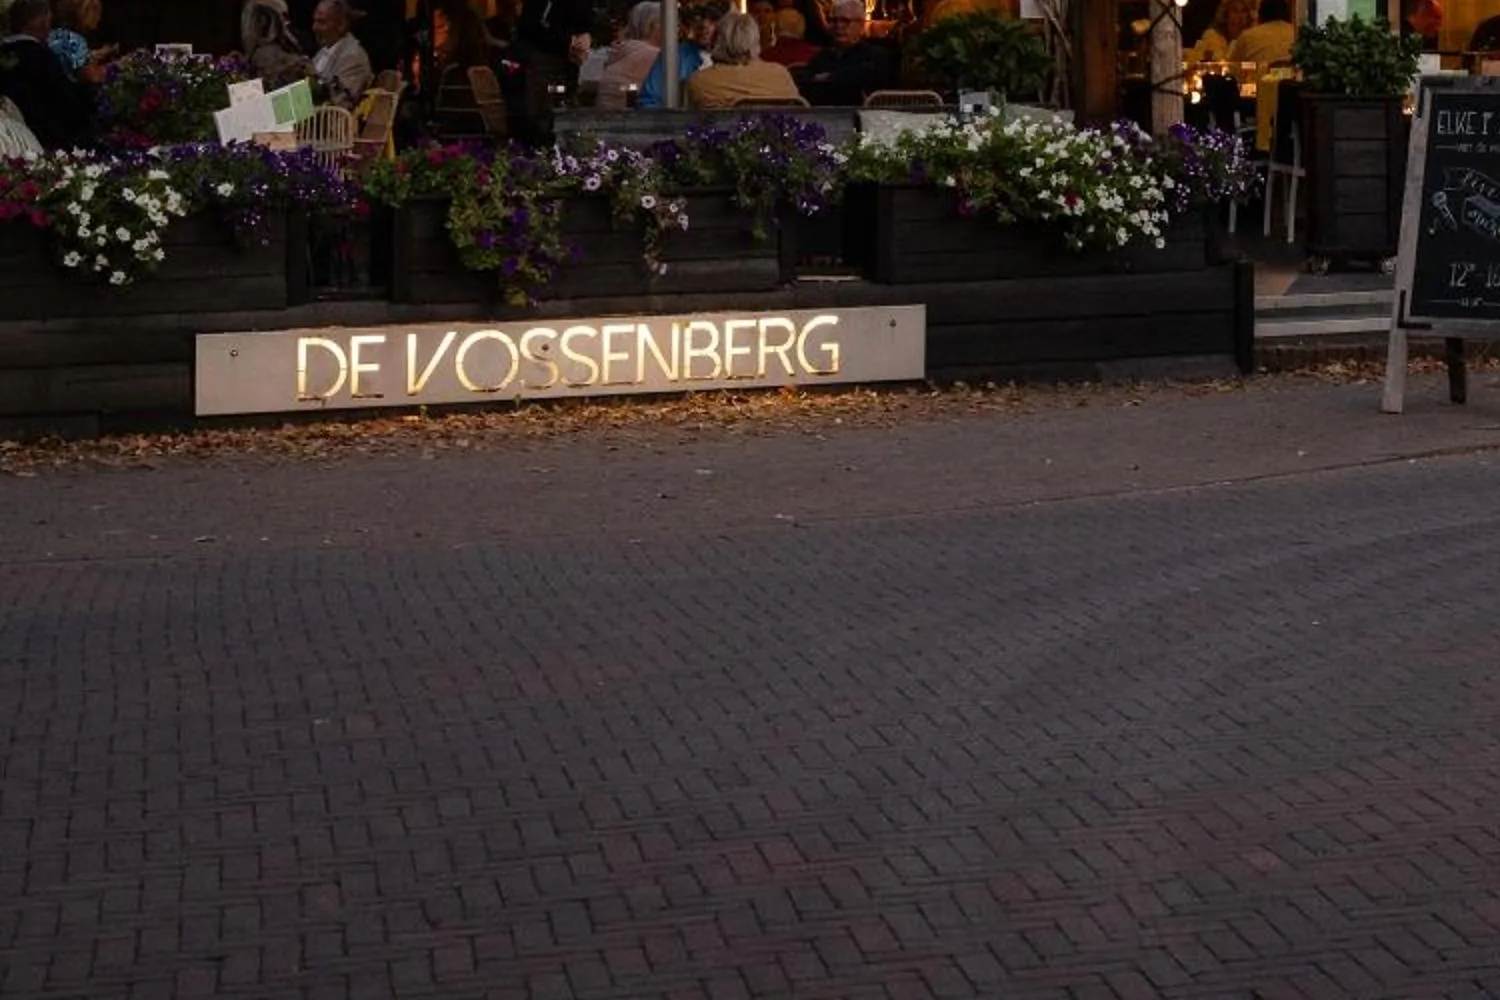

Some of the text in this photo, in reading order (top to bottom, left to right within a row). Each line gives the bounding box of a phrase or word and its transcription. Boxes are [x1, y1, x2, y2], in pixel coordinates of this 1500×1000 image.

[1437, 110, 1477, 136] ELKE
[296, 315, 841, 400] DE VOSSENBERG
